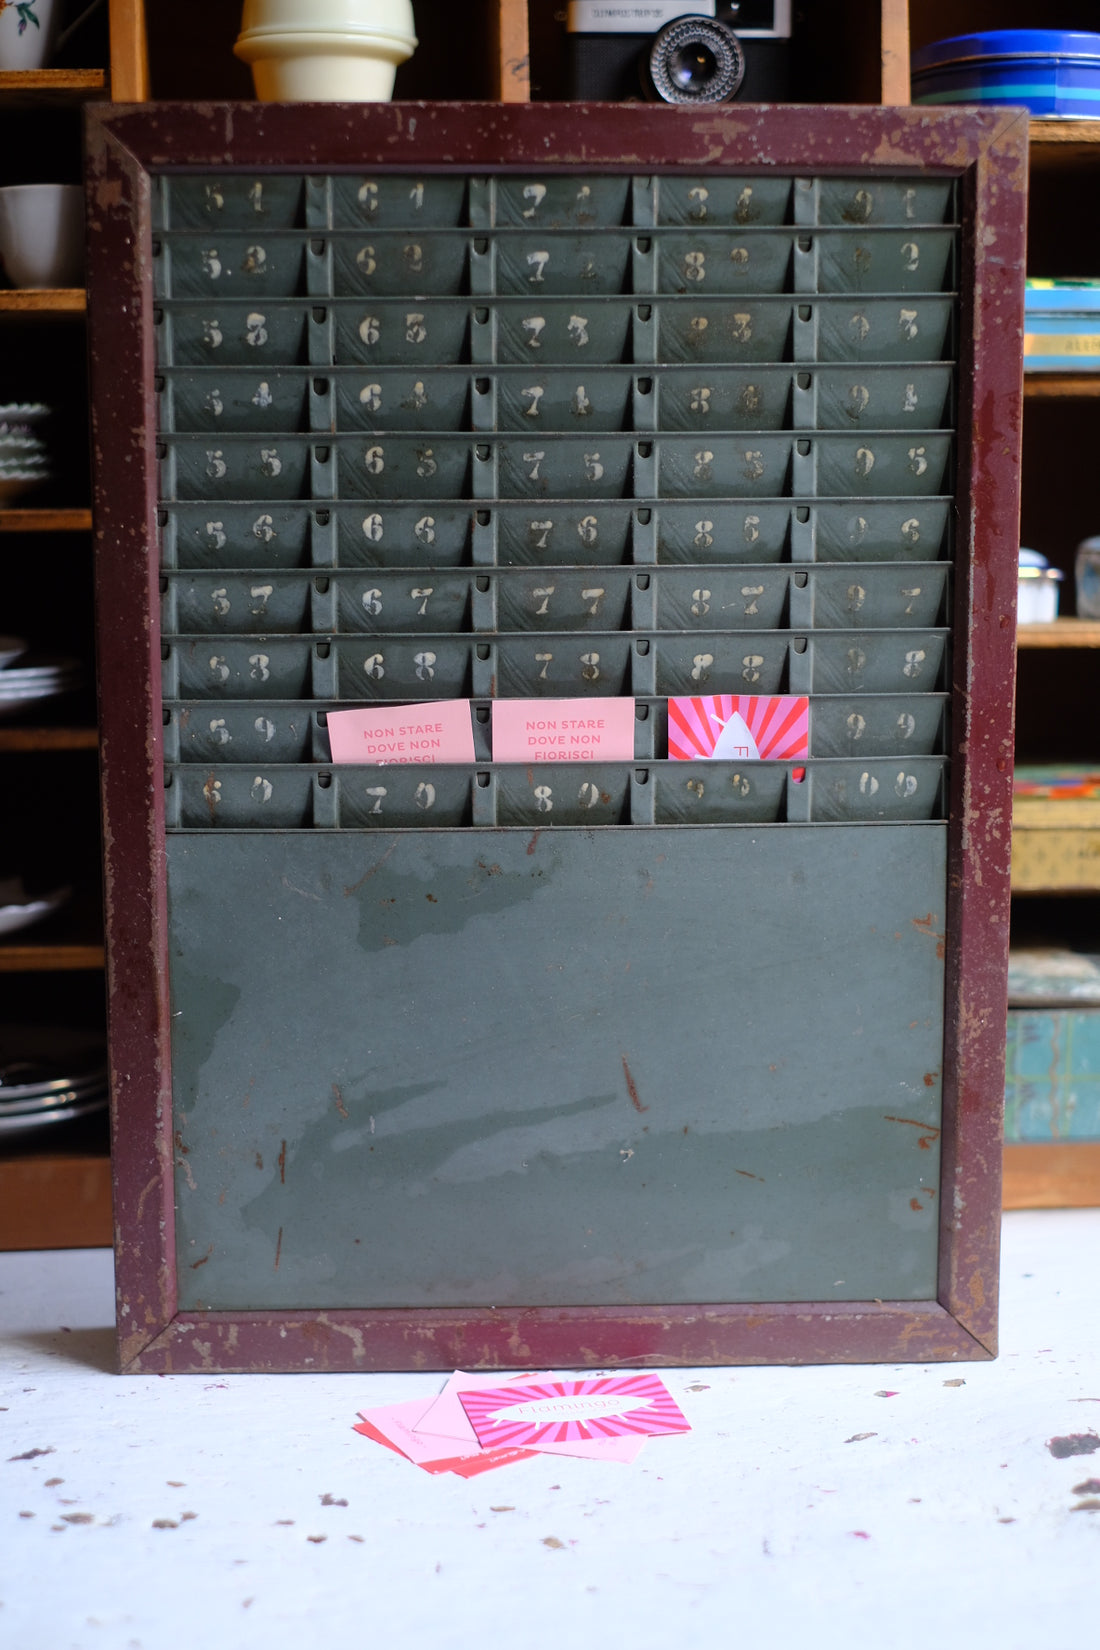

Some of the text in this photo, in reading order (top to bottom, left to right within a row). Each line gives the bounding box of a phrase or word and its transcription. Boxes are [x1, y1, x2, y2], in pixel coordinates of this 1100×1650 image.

[364, 723, 443, 739] NON STARE
[526, 719, 605, 730] NON STARE
[368, 739, 440, 754] DOVE NON
[528, 735, 600, 745] DOVE NON
[535, 750, 594, 760] FIORISCI
[518, 1398, 620, 1414] Flamingo
